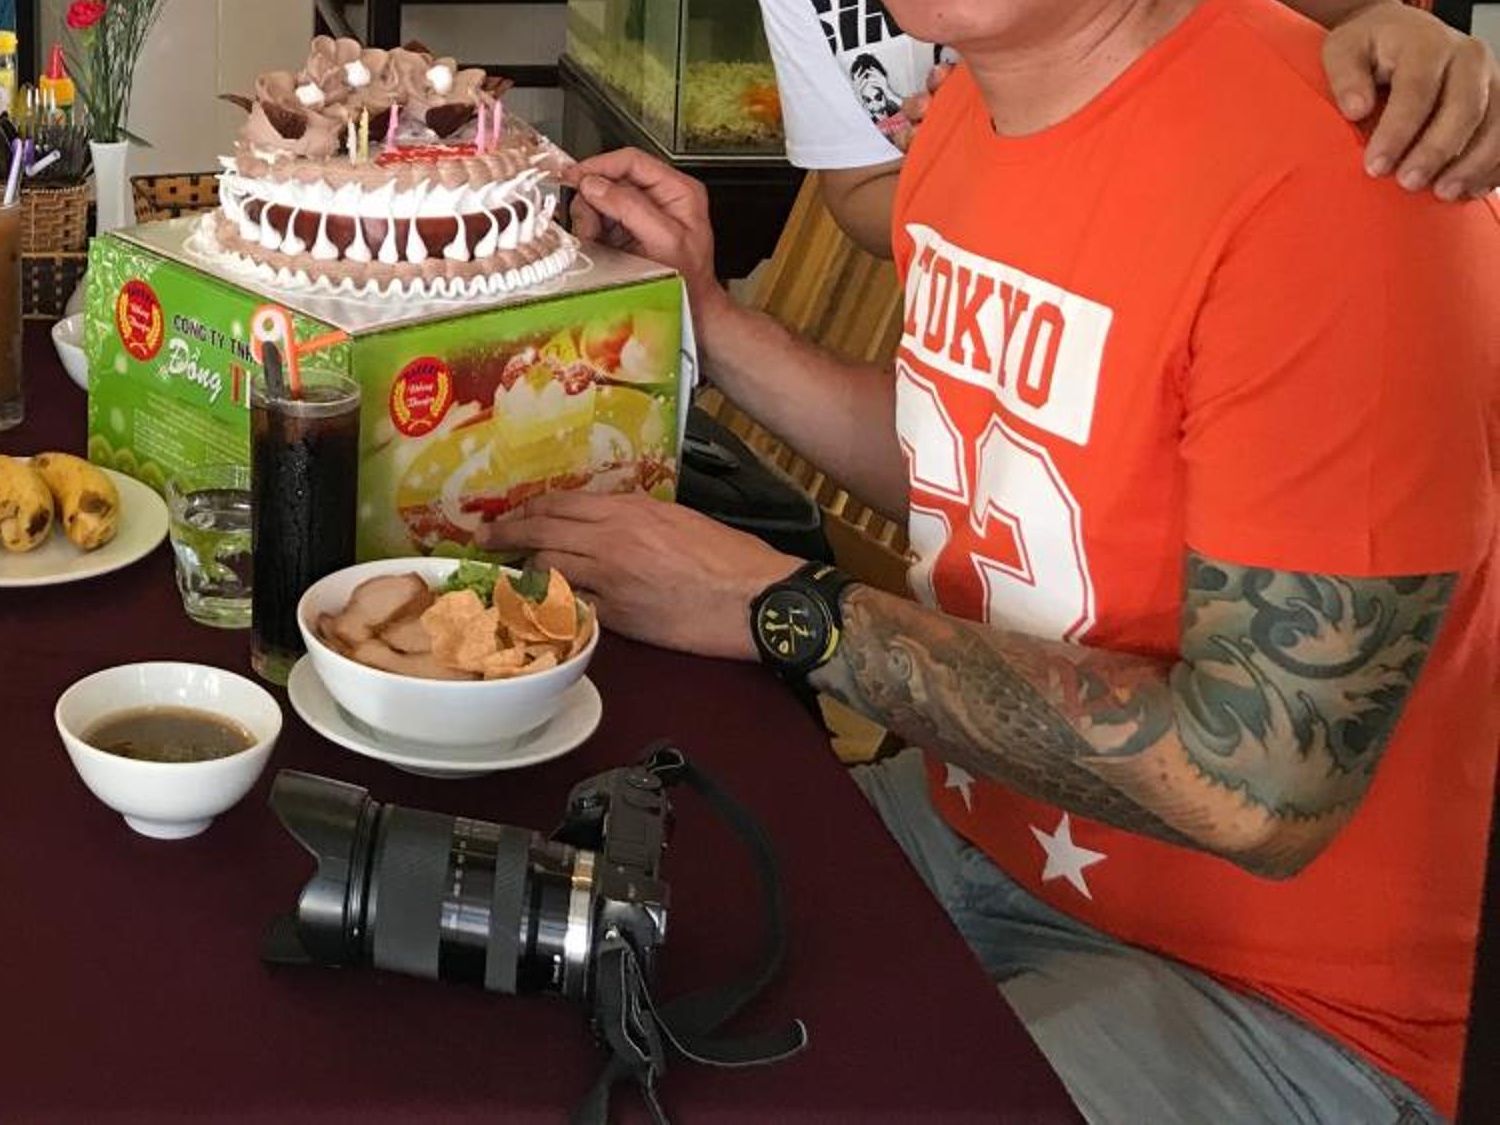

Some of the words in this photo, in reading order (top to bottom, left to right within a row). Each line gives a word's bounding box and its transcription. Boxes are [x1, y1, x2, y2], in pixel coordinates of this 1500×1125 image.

[210, 329, 225, 349] TY
[230, 337, 257, 364] TNH
[903, 245, 1066, 410] TOKYO
